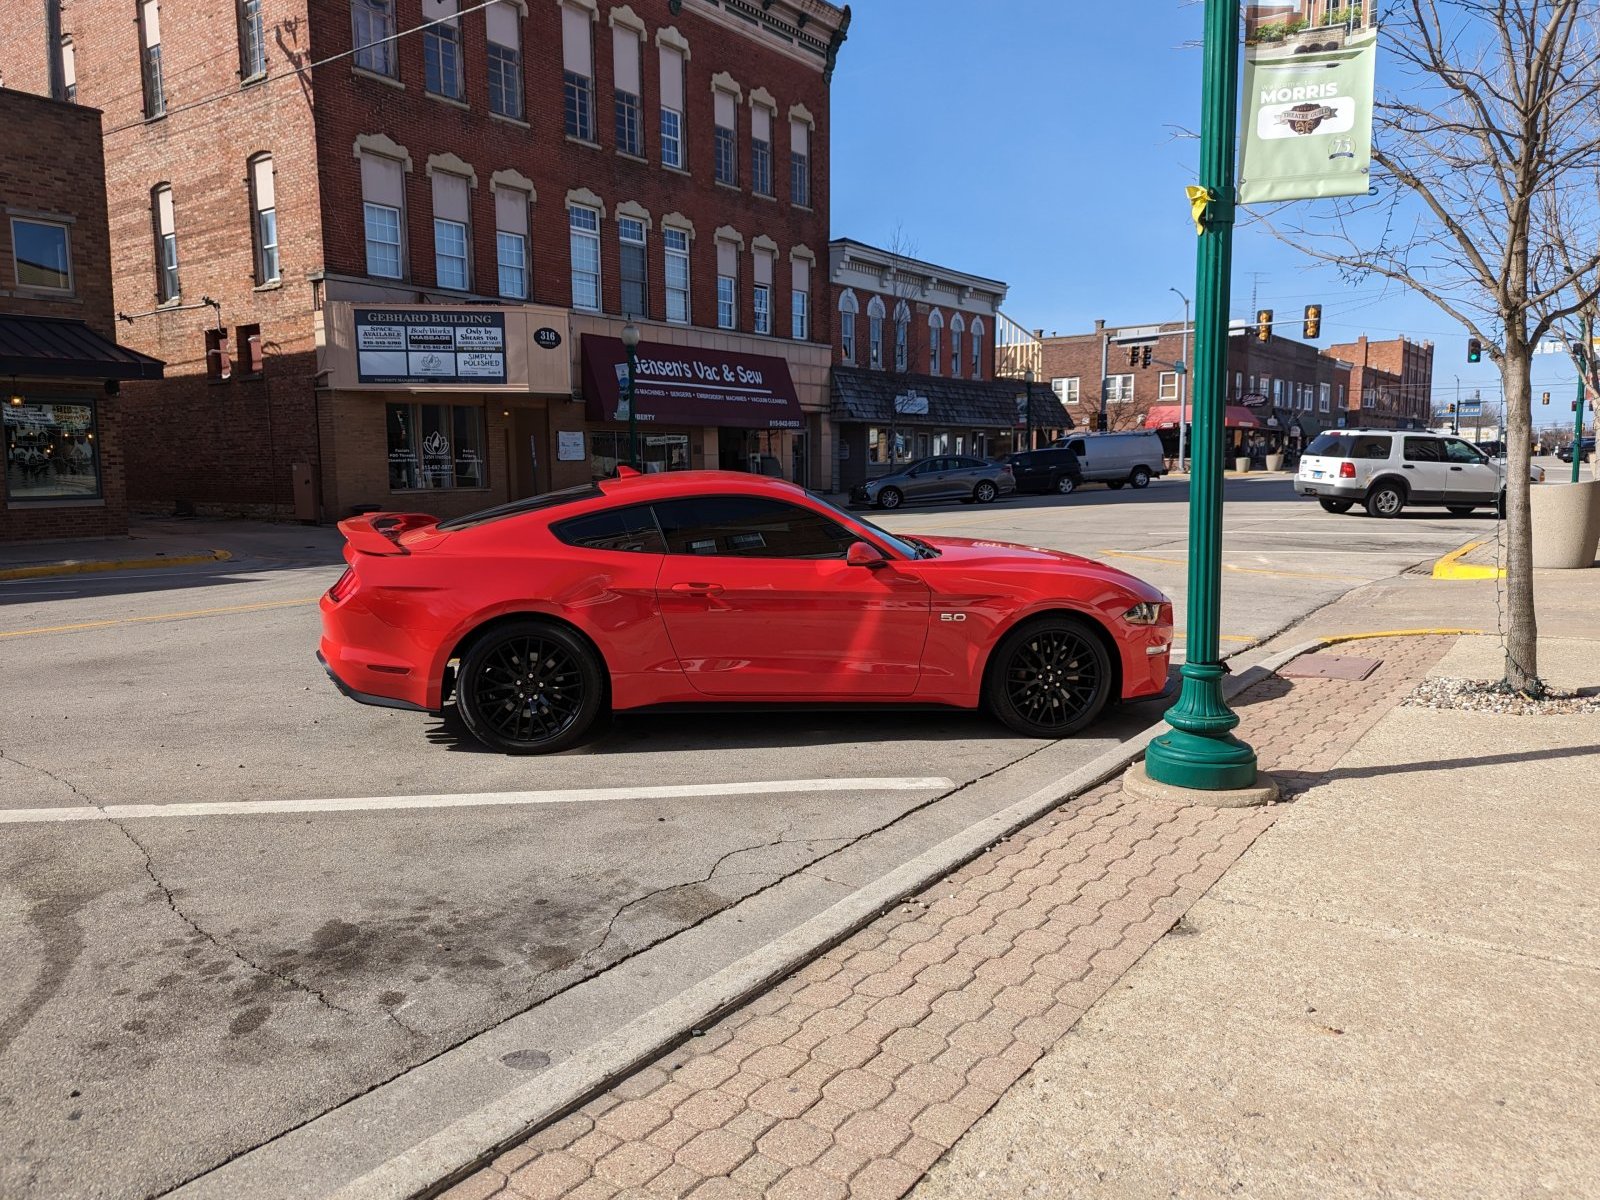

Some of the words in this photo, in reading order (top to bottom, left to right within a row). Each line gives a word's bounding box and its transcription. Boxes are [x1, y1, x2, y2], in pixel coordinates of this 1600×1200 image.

[1260, 82, 1338, 104] MORRIS
[367, 313, 428, 322] GEBHARD
[431, 314, 491, 324] BUILDING
[465, 327, 482, 335] Only
[540, 330, 556, 341] 316
[634, 354, 692, 378] Jensen's
[693, 361, 720, 380] Vac
[722, 364, 735, 382] &
[736, 366, 763, 385] Sew
